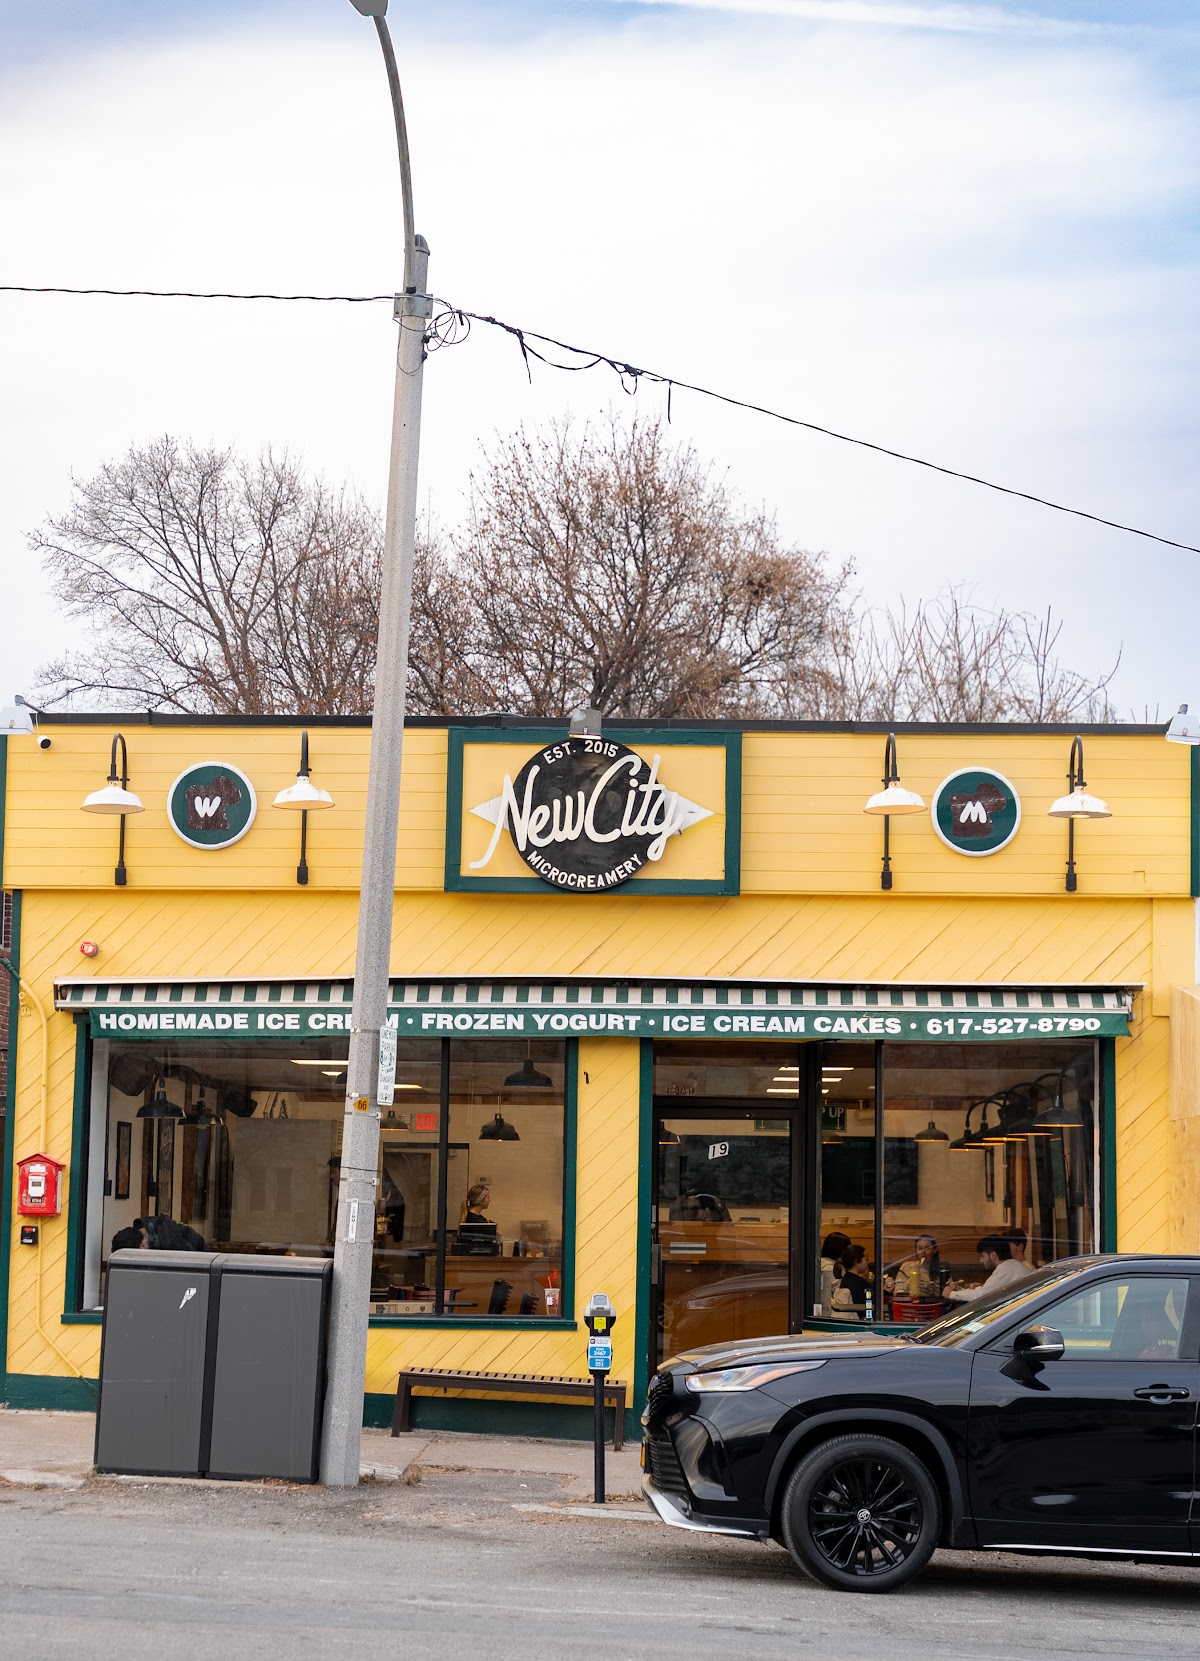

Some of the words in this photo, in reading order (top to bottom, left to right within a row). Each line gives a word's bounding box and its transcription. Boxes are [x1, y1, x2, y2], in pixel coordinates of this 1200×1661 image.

[543, 741, 577, 765] EST.
[585, 739, 619, 758] 2015
[526, 850, 643, 888] MICROCREAMERY
[99, 1012, 249, 1030] HOMEMADE
[257, 1013, 300, 1030] ICE
[421, 1013, 525, 1031] FROZEN
[532, 1013, 641, 1031] YOGURT
[662, 1014, 706, 1032] ICE
[713, 1015, 805, 1033] CREAM
[813, 1016, 902, 1034] CAKES
[926, 1017, 1101, 1035] 617-527-8790
[357, 1099, 367, 1111] 66
[828, 1106, 845, 1118] UP
[416, 1113, 437, 1131] EXIT
[712, 1143, 728, 1158] 19
